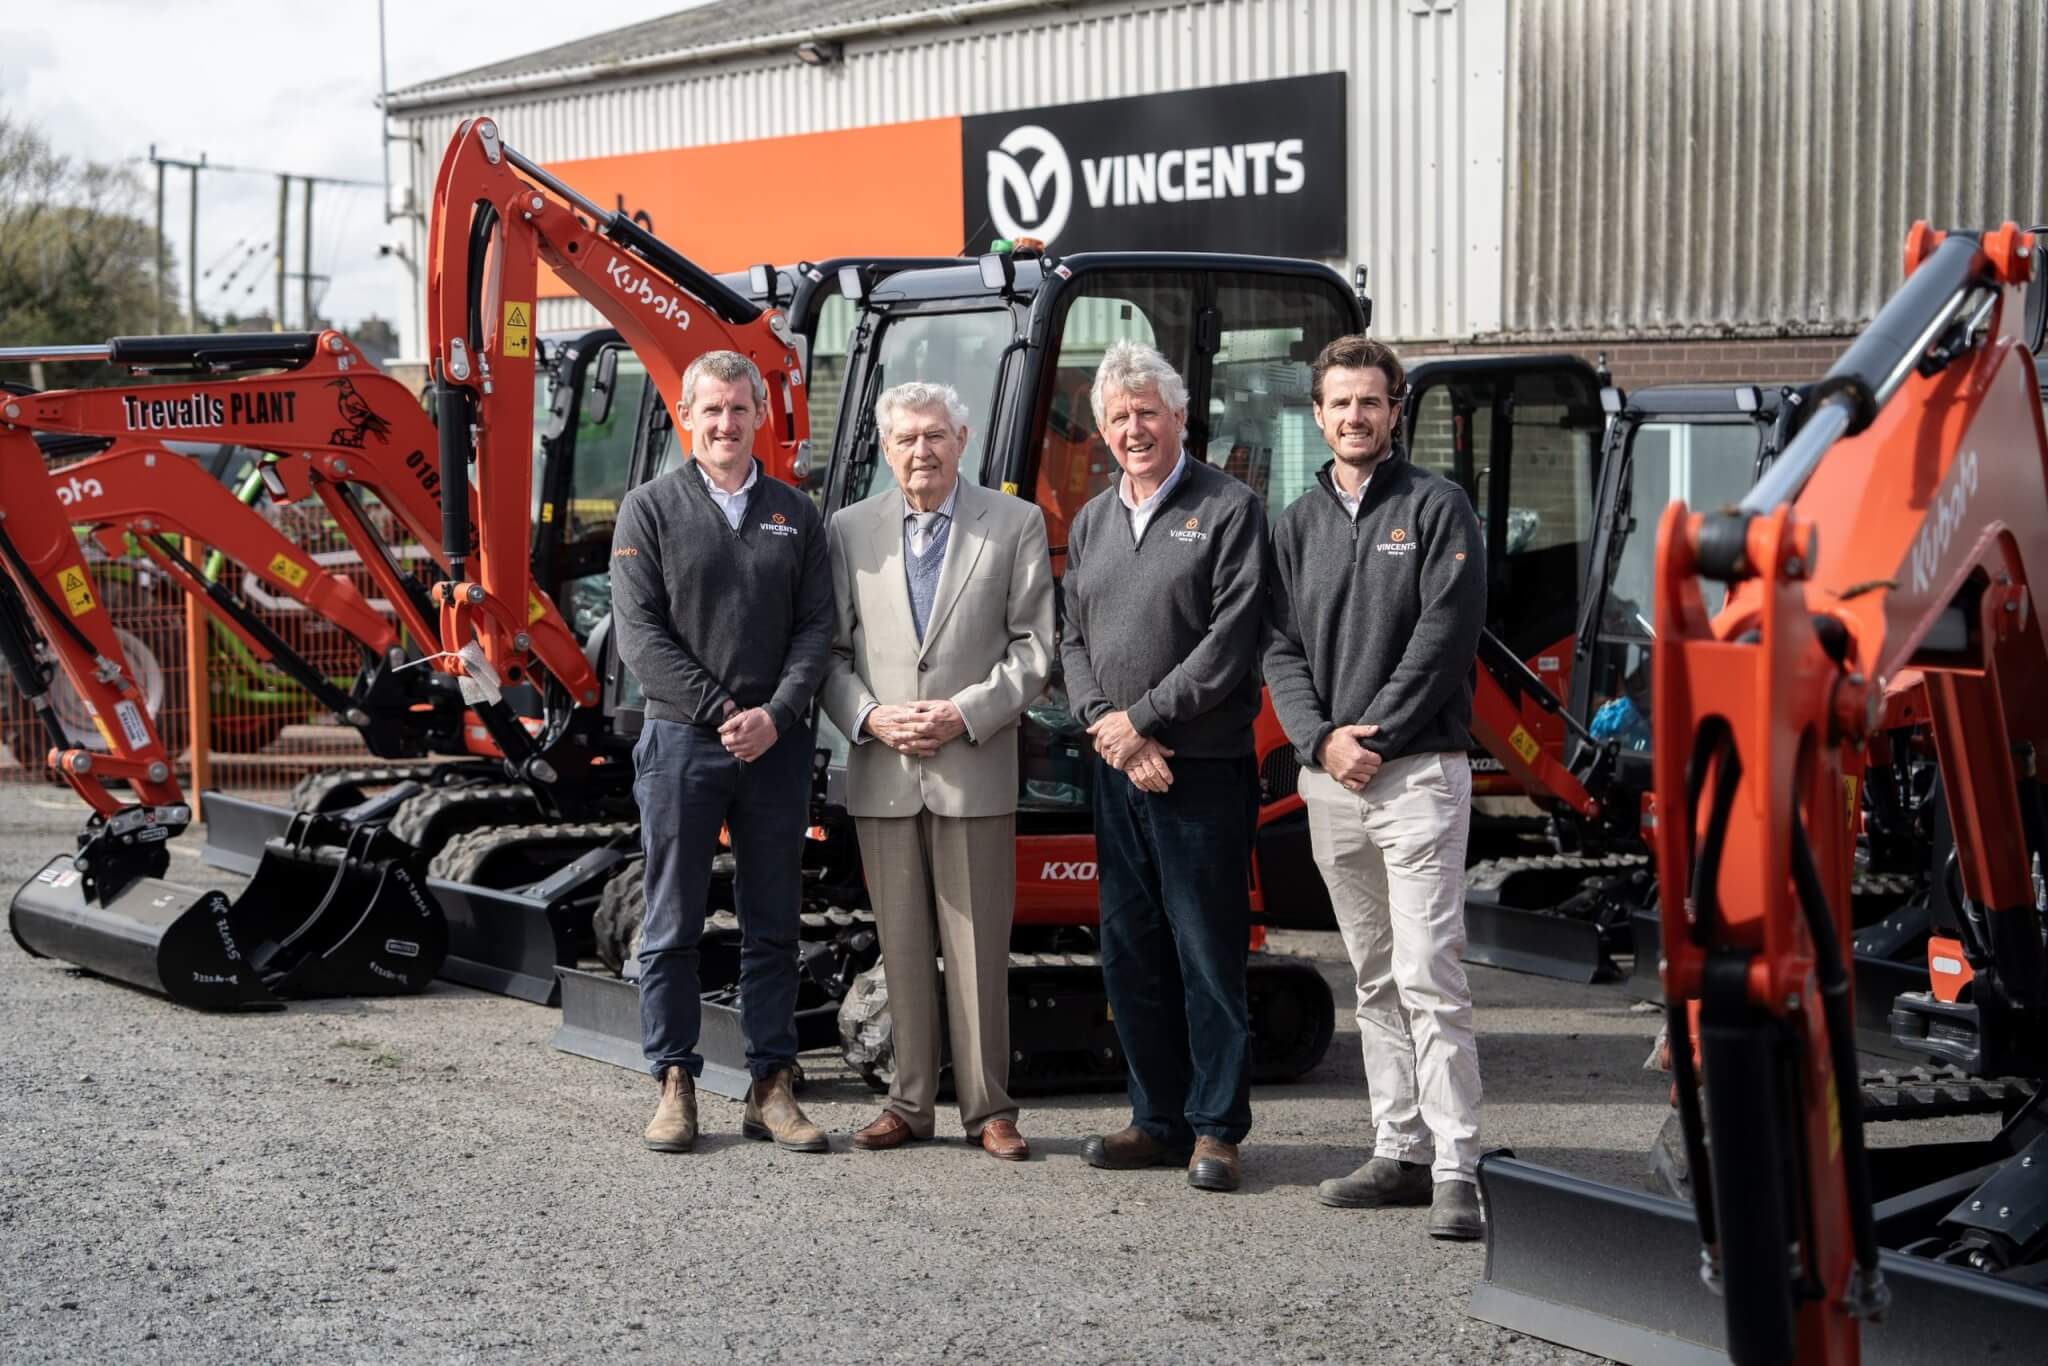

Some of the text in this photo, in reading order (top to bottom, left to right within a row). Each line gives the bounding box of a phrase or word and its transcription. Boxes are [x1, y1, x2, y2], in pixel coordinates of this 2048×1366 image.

[1081, 138, 1305, 208] VINCENTS
[606, 256, 690, 331] Kubota
[122, 391, 296, 431] Trevails PLANT
[56, 477, 104, 505] ota
[760, 523, 798, 535] VINCENTS
[1170, 529, 1207, 540] VINCENTS
[1912, 449, 1979, 595] Kubota
[1376, 542, 1416, 551] VINCENTS
